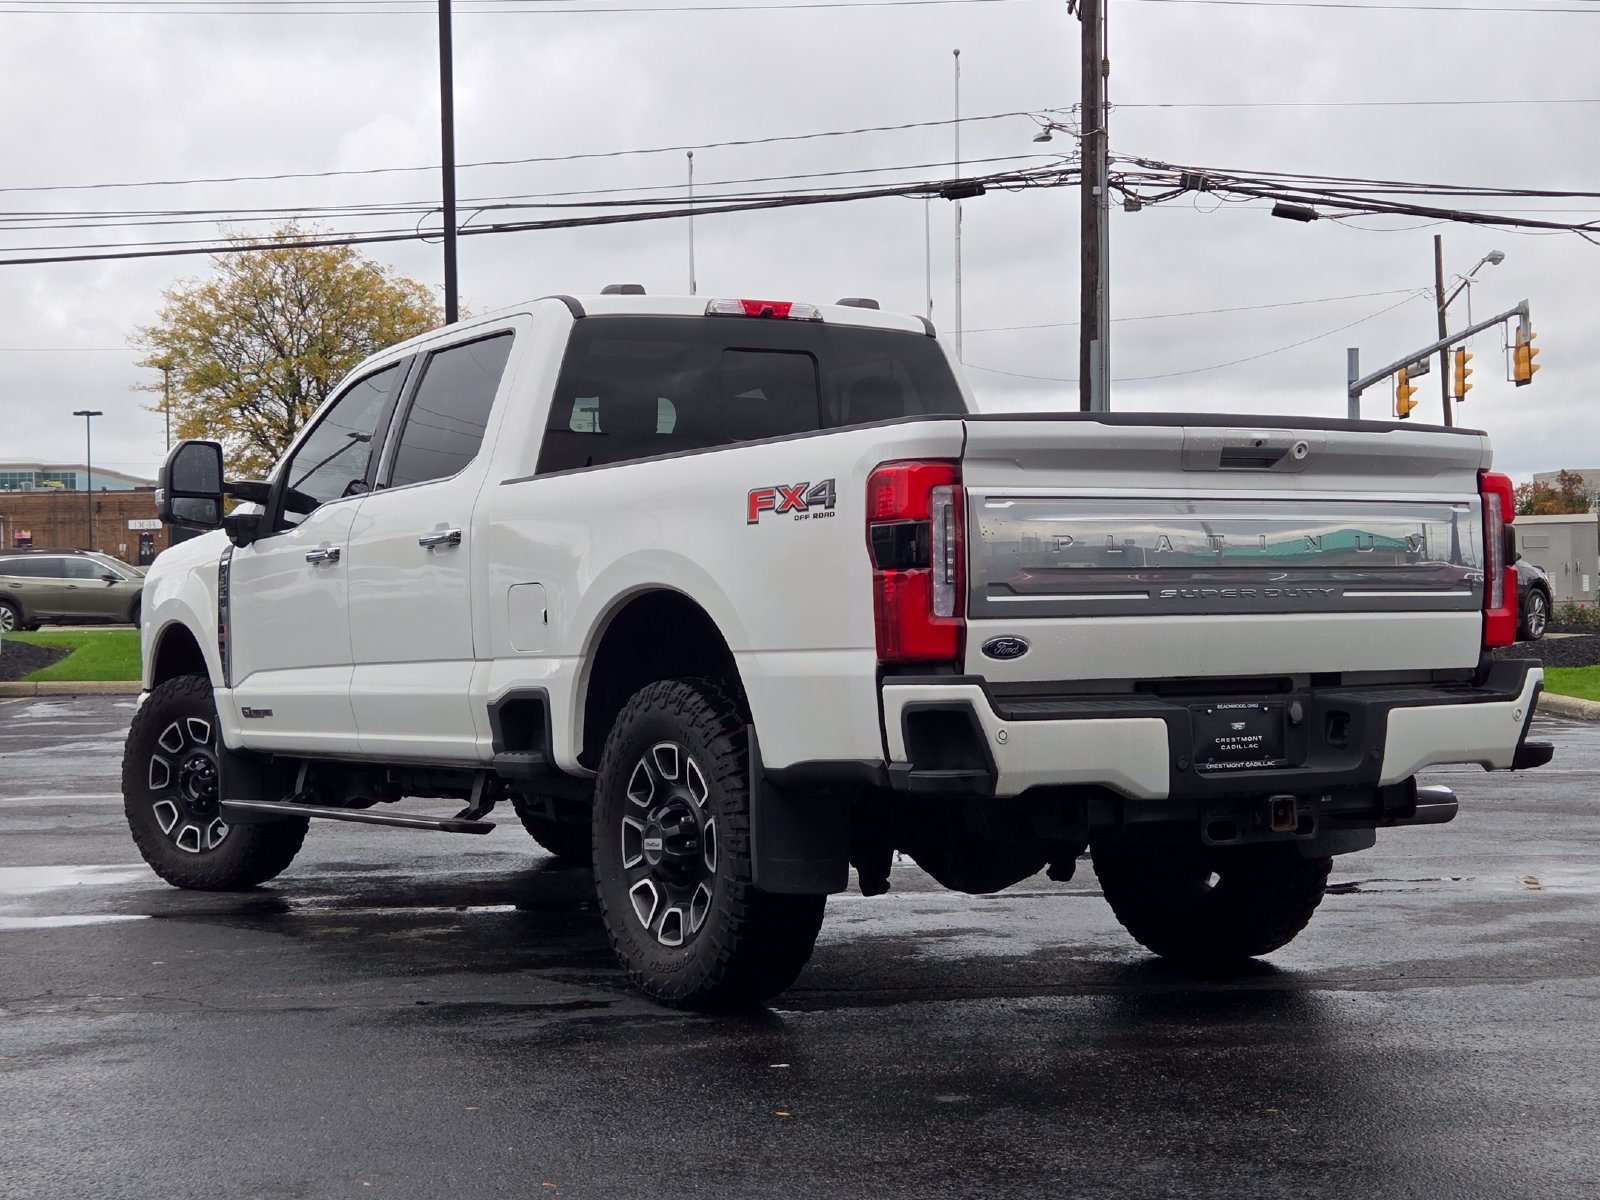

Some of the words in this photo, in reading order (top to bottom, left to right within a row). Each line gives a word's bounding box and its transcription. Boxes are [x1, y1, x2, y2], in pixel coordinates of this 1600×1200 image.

[747, 478, 836, 525] FX4
[794, 513, 810, 521] OFF
[812, 511, 835, 519] ROAD
[1052, 534, 1425, 553] PLATINUM
[1160, 588, 1257, 599] SUPER
[1264, 588, 1335, 598] DUTY
[994, 641, 1020, 655] Ford
[1215, 735, 1263, 743] CRESTMONT
